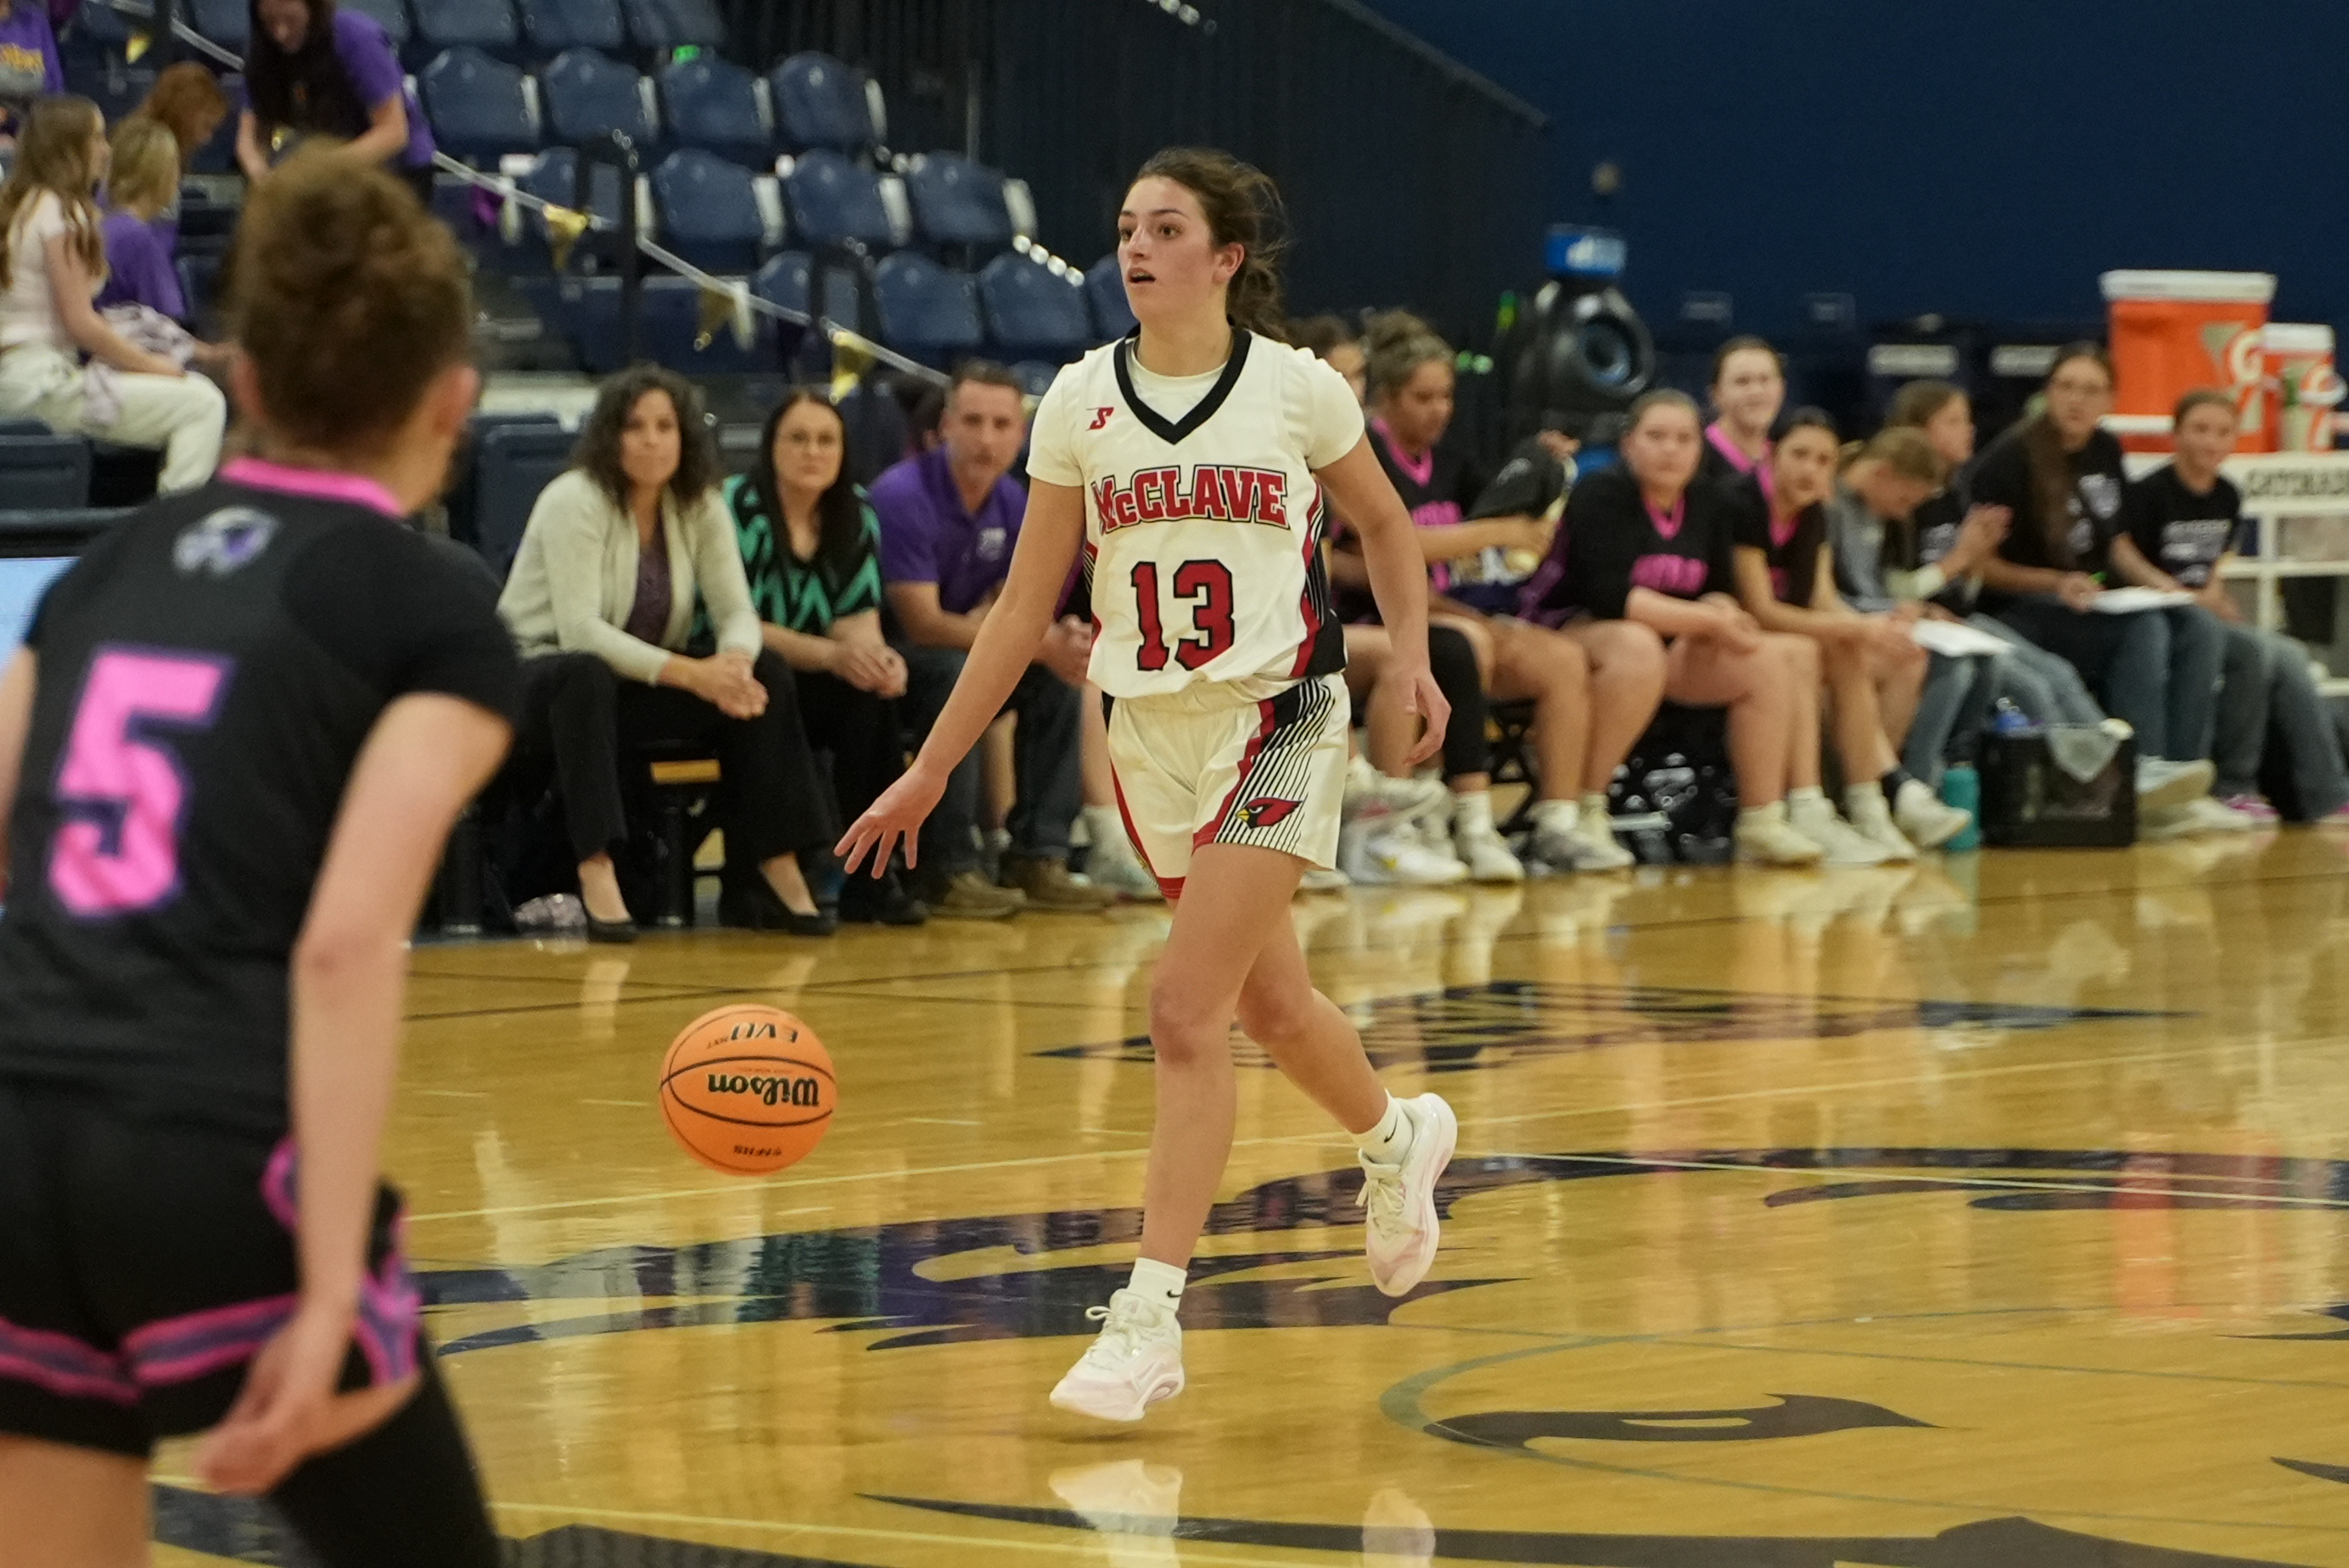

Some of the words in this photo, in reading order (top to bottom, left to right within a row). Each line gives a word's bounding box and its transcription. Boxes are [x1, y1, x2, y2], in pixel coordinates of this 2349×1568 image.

[1090, 464, 1291, 535] McCLAVE
[1130, 559, 1235, 671] 13
[48, 645, 233, 916] 5
[708, 1073, 820, 1107] Wilson
